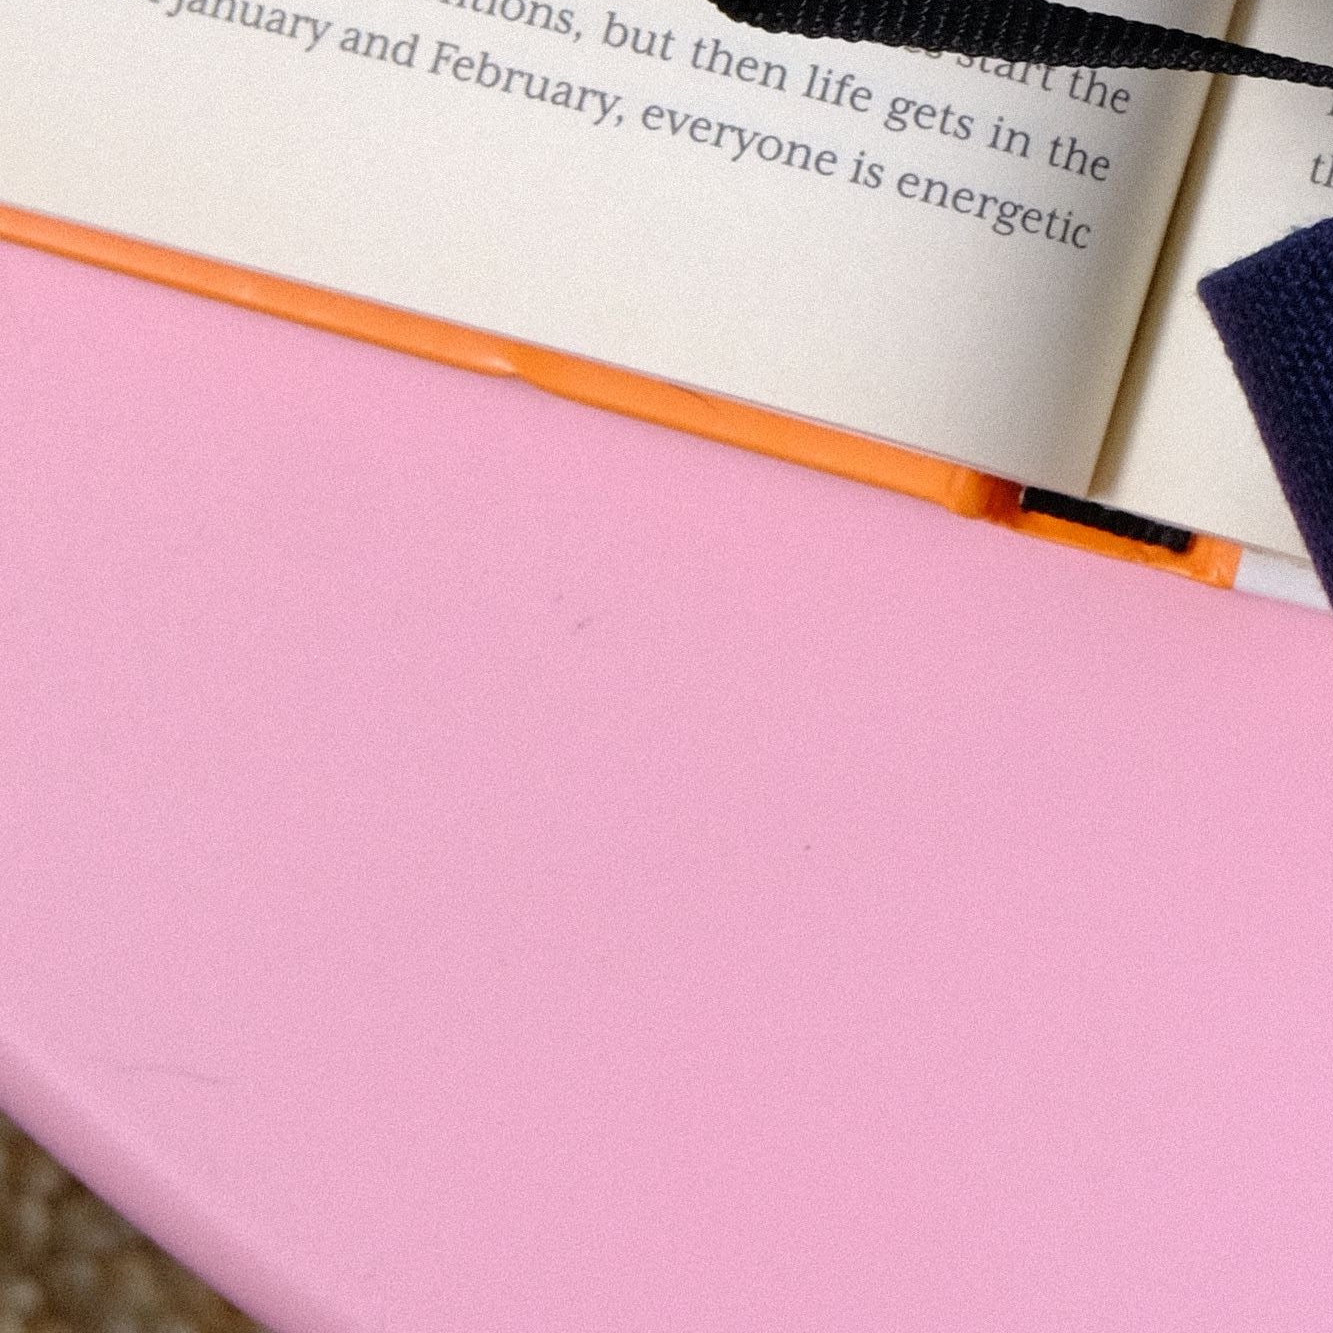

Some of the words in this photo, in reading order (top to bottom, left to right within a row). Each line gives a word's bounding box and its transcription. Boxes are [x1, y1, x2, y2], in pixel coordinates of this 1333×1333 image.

[338, 27, 421, 69] and
[428, 40, 625, 127] February,
[640, 104, 839, 177] everyone
[848, 150, 885, 190] is
[895, 171, 1091, 250] energetic
[601, 10, 676, 62] but
[690, 37, 788, 92] then
[802, 63, 873, 113] life
[882, 96, 975, 141] gets
[987, 116, 1031, 159] in
[1048, 136, 1110, 182] the
[1068, 74, 1131, 114] the
